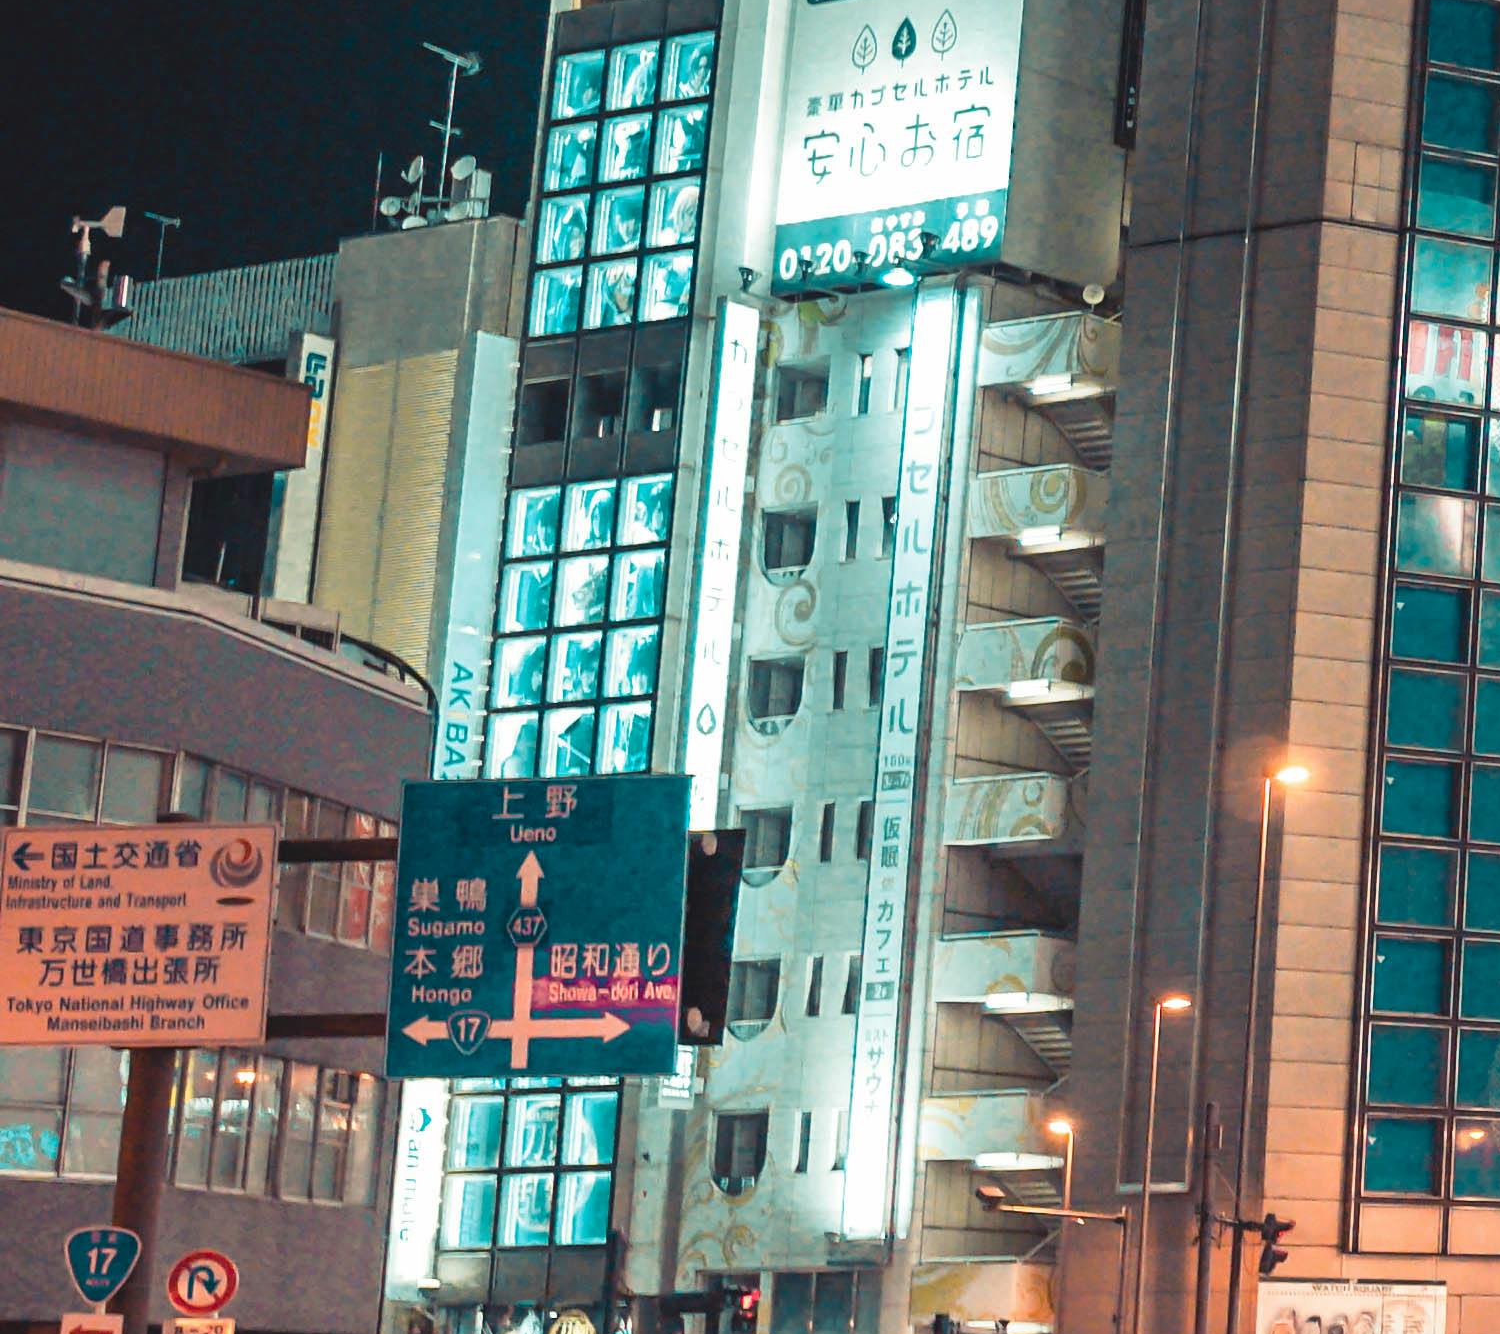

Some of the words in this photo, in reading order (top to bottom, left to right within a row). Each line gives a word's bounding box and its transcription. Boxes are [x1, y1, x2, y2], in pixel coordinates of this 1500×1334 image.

[803, 103, 992, 185] 安心お宿
[491, 784, 578, 820] 上野
[510, 824, 557, 843] Ueno
[881, 814, 903, 868] 仮眠
[51, 841, 203, 871] 国土交通省
[8, 875, 58, 893] Ministry
[62, 874, 76, 889] of
[407, 877, 488, 913] 巣鴨
[5, 893, 93, 911] Infrastructure
[97, 892, 121, 909] and
[126, 892, 187, 911] Transport
[16, 922, 248, 955] 東京国道事務所
[407, 917, 485, 938] Sugamo
[512, 917, 544, 936] 437
[874, 898, 895, 975] カフェ
[38, 955, 222, 988] 万世橋出張所
[404, 944, 484, 980] 本郷
[550, 942, 672, 978] 昭和通り
[7, 996, 53, 1015] Tokyo
[59, 995, 125, 1012] National
[129, 994, 196, 1012] Highway
[202, 993, 249, 1010] Office
[411, 984, 473, 1005] Hongo
[549, 981, 638, 1003] Showa-dori
[644, 981, 676, 1002] Ave.
[47, 1016, 144, 1032] Manseibashi
[150, 1015, 206, 1031] Branch
[456, 1018, 481, 1043] 17
[86, 1246, 118, 1276] 17
[1311, 1283, 1351, 1293] WATCH
